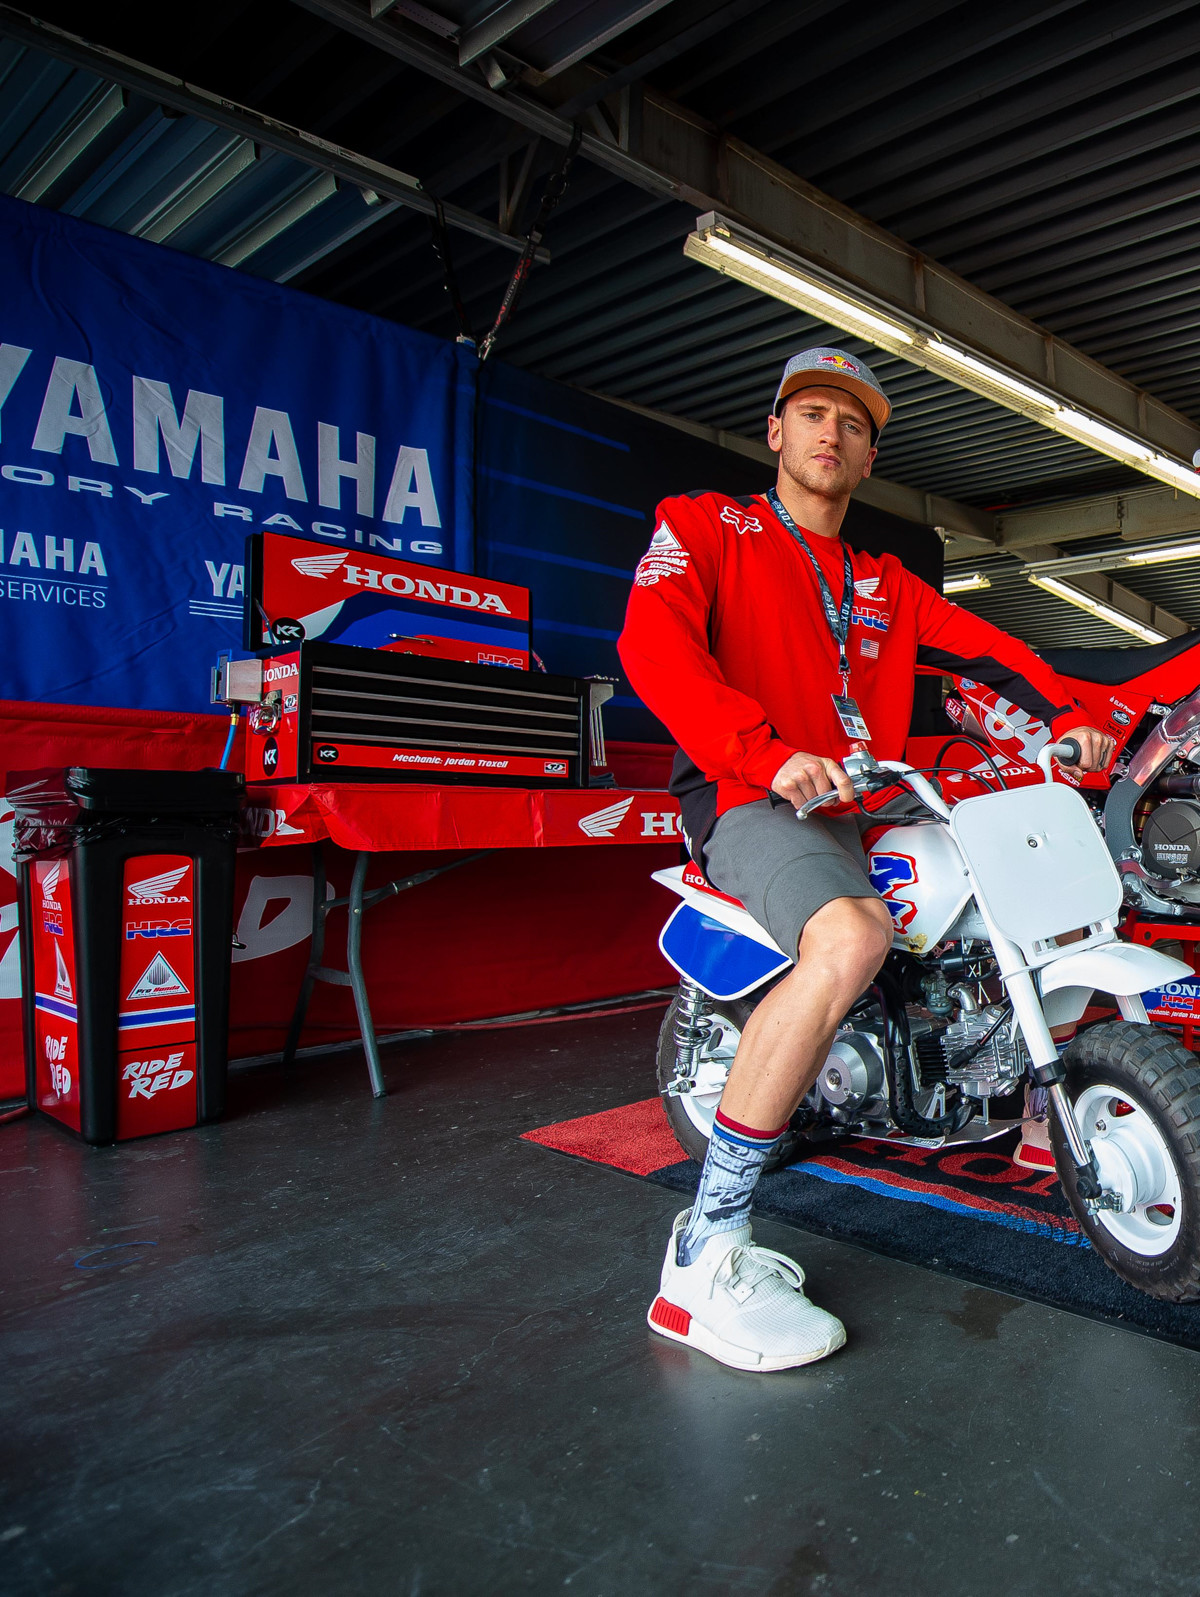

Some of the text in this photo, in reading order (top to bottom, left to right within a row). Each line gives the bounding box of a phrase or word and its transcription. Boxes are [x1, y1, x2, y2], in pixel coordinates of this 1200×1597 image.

[778, 508, 795, 527] FOX
[213, 502, 443, 555] RACING
[0, 529, 108, 577] AHA
[342, 563, 512, 615] HONDA
[826, 602, 838, 623] FOX
[841, 602, 850, 621] FOX
[851, 606, 890, 632] HRC
[392, 754, 508, 768] Mechanic: Jordan Troxell
[1154, 843, 1191, 852] HONDA
[42, 899, 62, 912] HONDA
[127, 896, 191, 905] HONDA
[126, 918, 192, 940] HRC
[153, 985, 180, 993] Honda
[1160, 995, 1195, 1011] HRC
[45, 1034, 68, 1062] RIDE
[121, 1052, 185, 1080] RIDE
[50, 1062, 71, 1099] RED
[128, 1070, 194, 1100] RED
